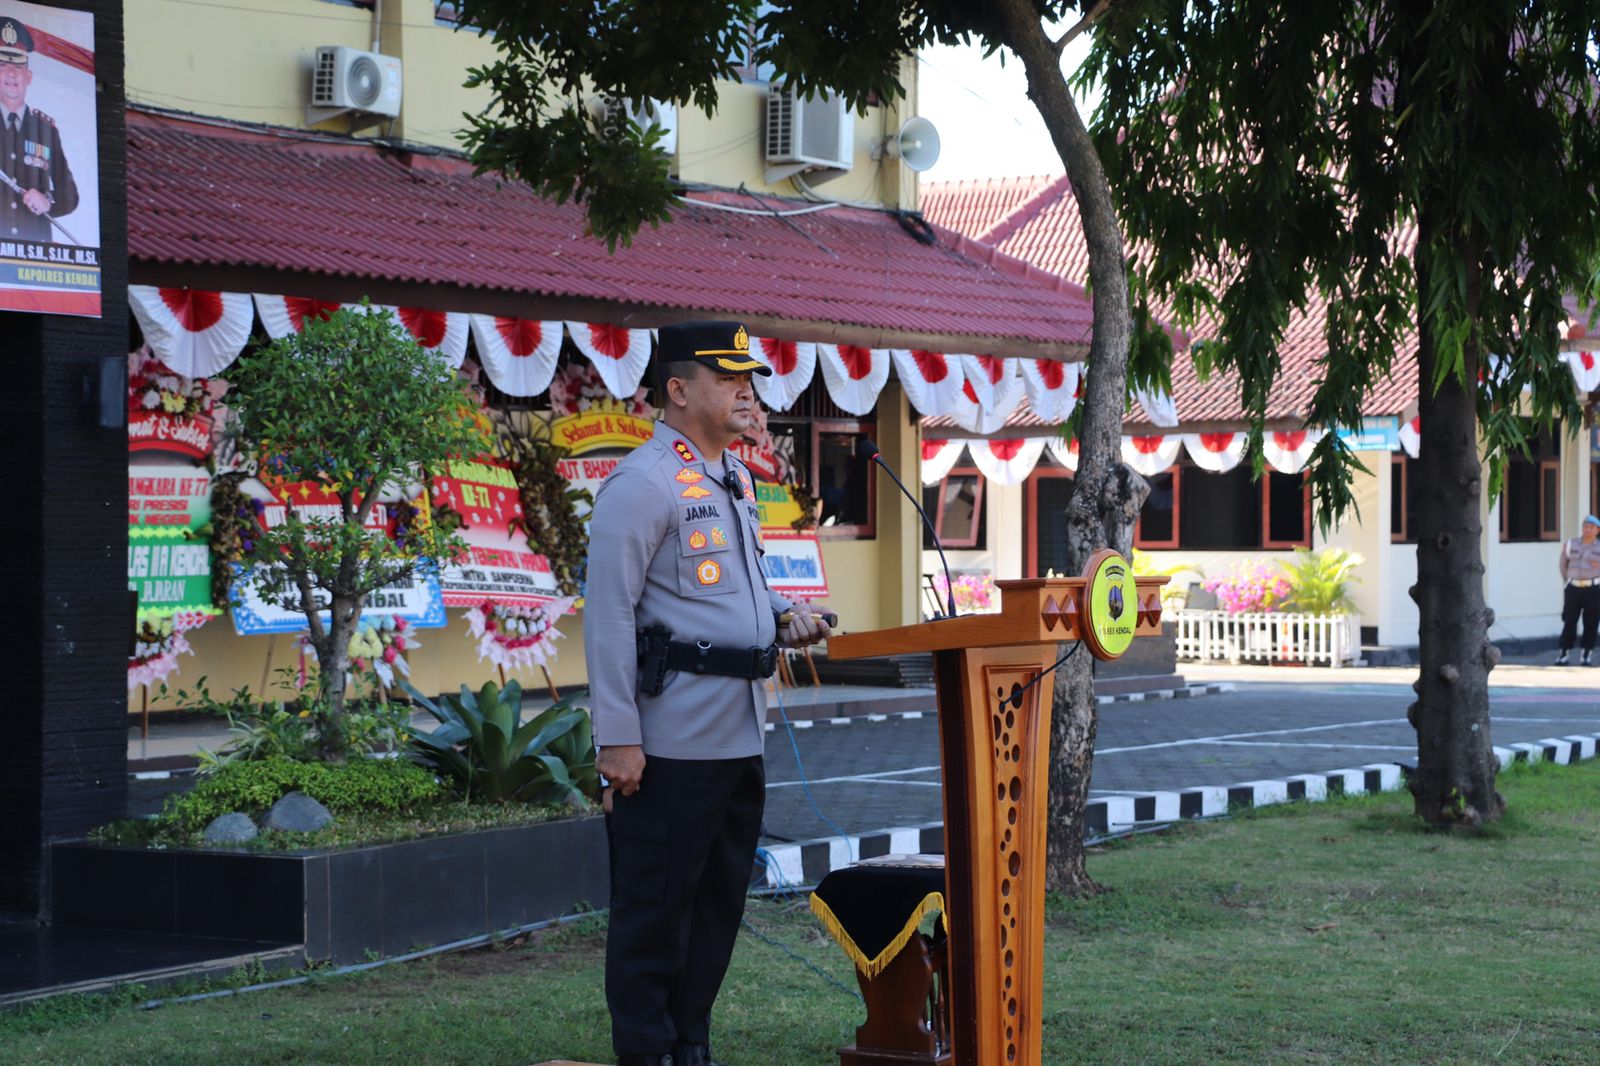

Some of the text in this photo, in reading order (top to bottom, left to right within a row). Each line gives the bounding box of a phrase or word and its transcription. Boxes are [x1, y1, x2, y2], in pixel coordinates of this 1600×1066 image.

[17, 267, 98, 286] KAPOLRES KENDAL
[604, 416, 614, 433] &
[195, 478, 209, 496] 77
[685, 504, 720, 522] JAMAL
[462, 569, 487, 582] MITRA
